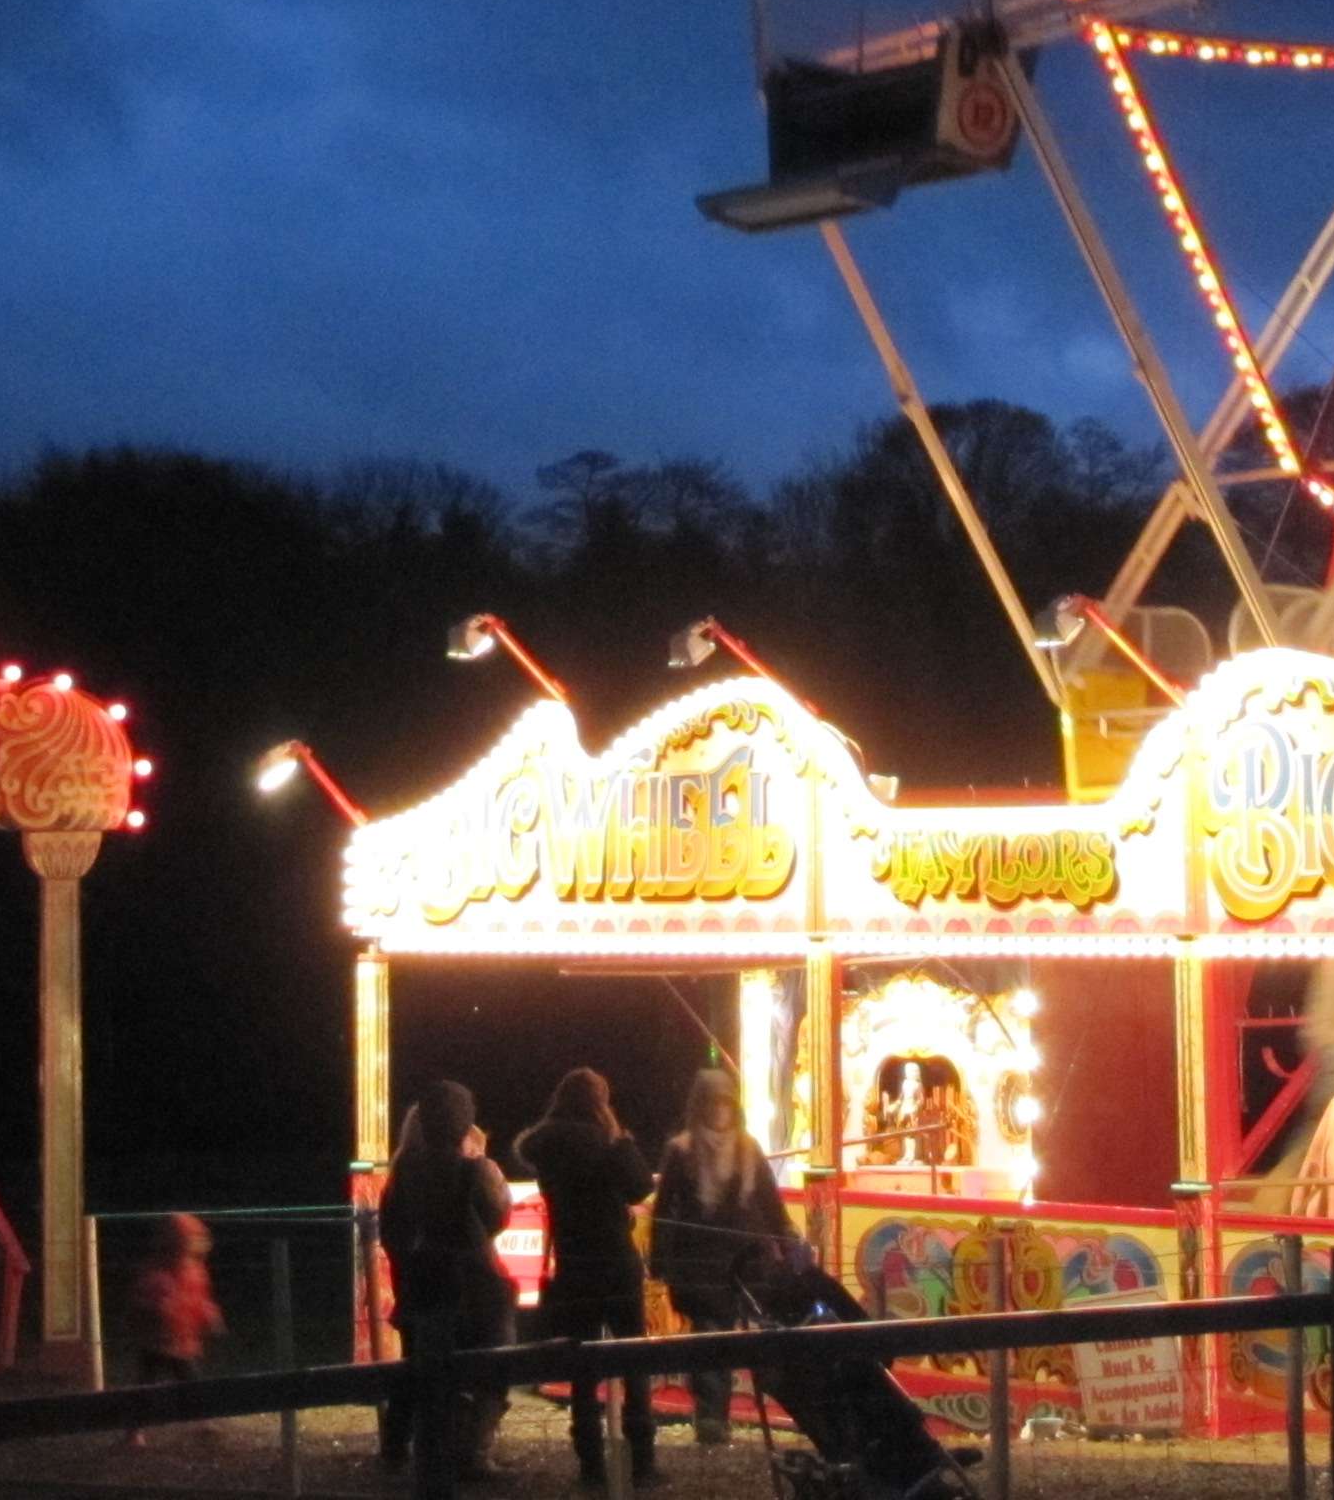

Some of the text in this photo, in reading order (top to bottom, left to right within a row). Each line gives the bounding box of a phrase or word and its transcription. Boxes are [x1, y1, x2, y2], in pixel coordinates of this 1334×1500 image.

[537, 744, 795, 901] WHEEL
[873, 830, 1120, 911] TAYLORS
[1101, 1354, 1156, 1378] Must Be
